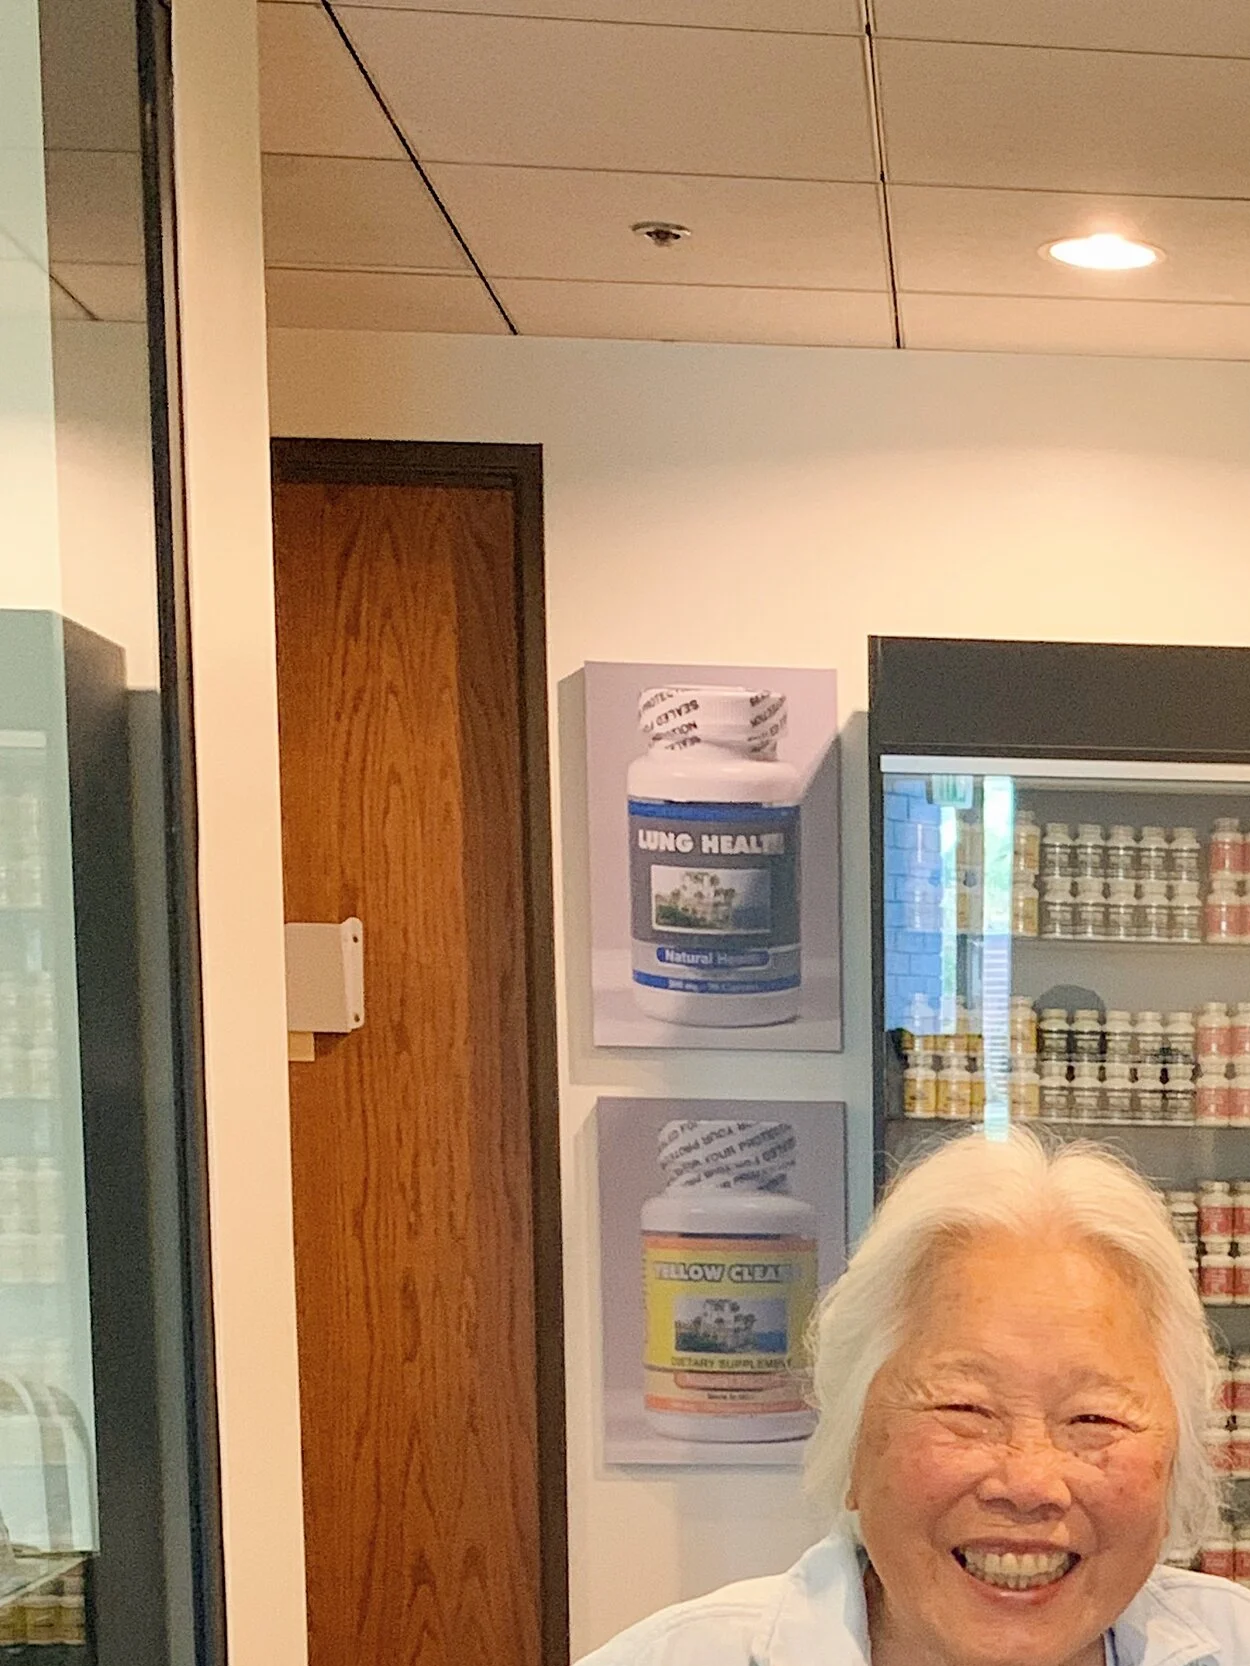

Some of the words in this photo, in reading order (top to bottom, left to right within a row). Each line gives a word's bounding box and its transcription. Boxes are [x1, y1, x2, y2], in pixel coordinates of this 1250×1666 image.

[638, 829, 694, 853] LUNG
[664, 948, 714, 965] Natural
[729, 1264, 791, 1282] CLEA
